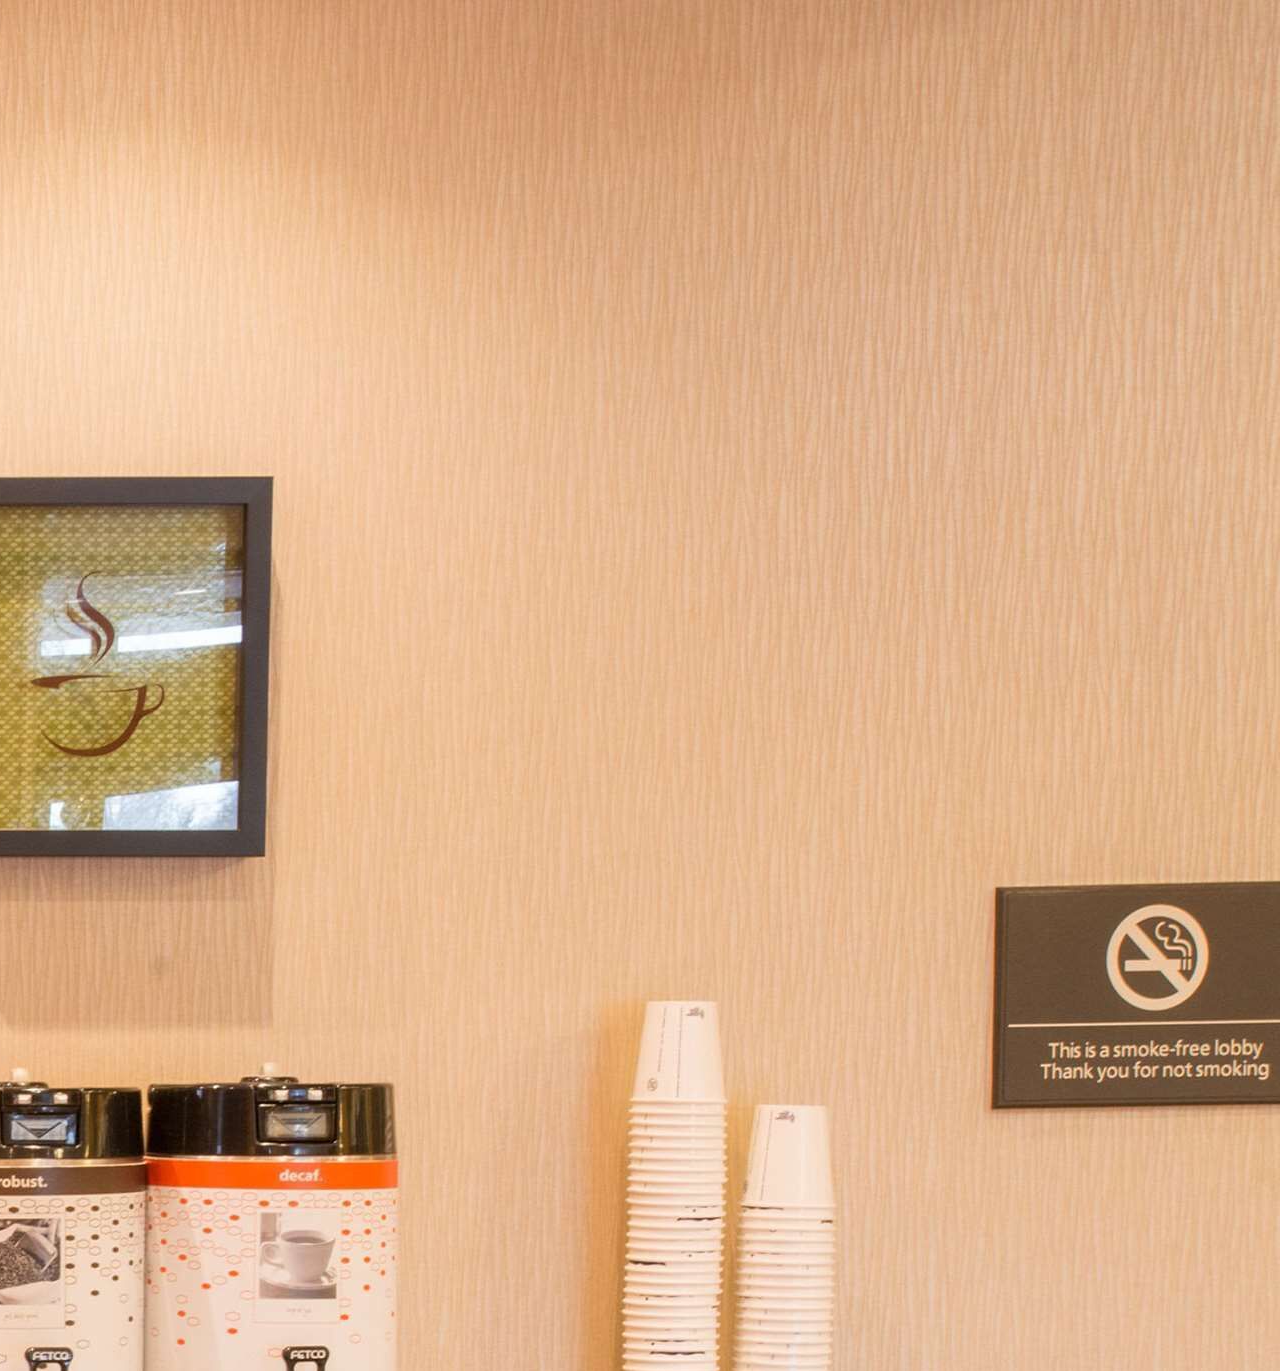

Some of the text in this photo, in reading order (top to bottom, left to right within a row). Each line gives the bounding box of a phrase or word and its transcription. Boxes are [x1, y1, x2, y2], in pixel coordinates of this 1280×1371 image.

[1048, 1038, 1263, 1059] This is a smoke-free lobby
[1041, 1060, 1270, 1083] Thank you for not smoking
[32, 1350, 71, 1362] FETCO
[289, 1349, 327, 1361] FETCO
